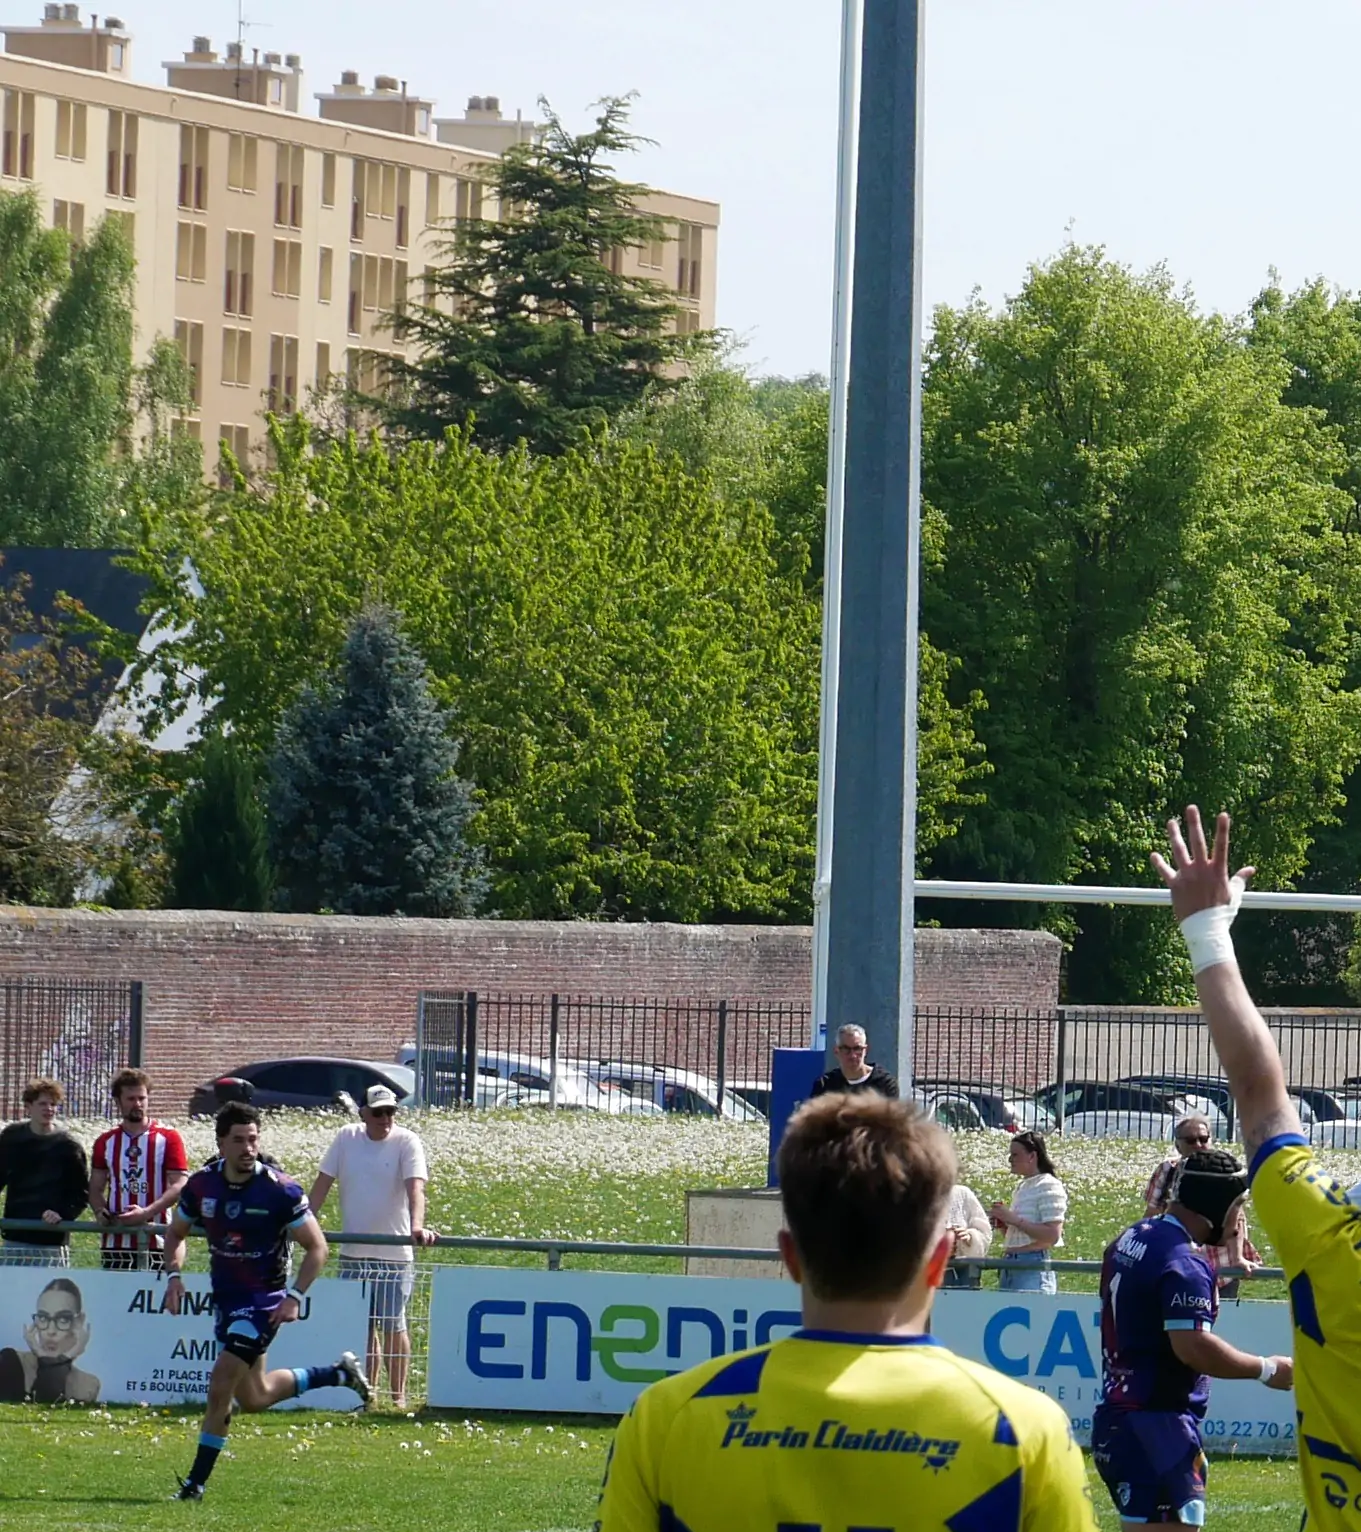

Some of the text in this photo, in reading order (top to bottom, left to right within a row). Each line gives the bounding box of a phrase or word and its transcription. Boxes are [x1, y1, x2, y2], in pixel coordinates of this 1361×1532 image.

[152, 1368, 164, 1379] 21
[168, 1369, 203, 1381] PLACE
[126, 1380, 137, 1391] ET
[1203, 1419, 1227, 1437] 03
[1231, 1420, 1254, 1438] 22
[1258, 1421, 1280, 1439] 70
[720, 1418, 961, 1458] Parin Claidière
